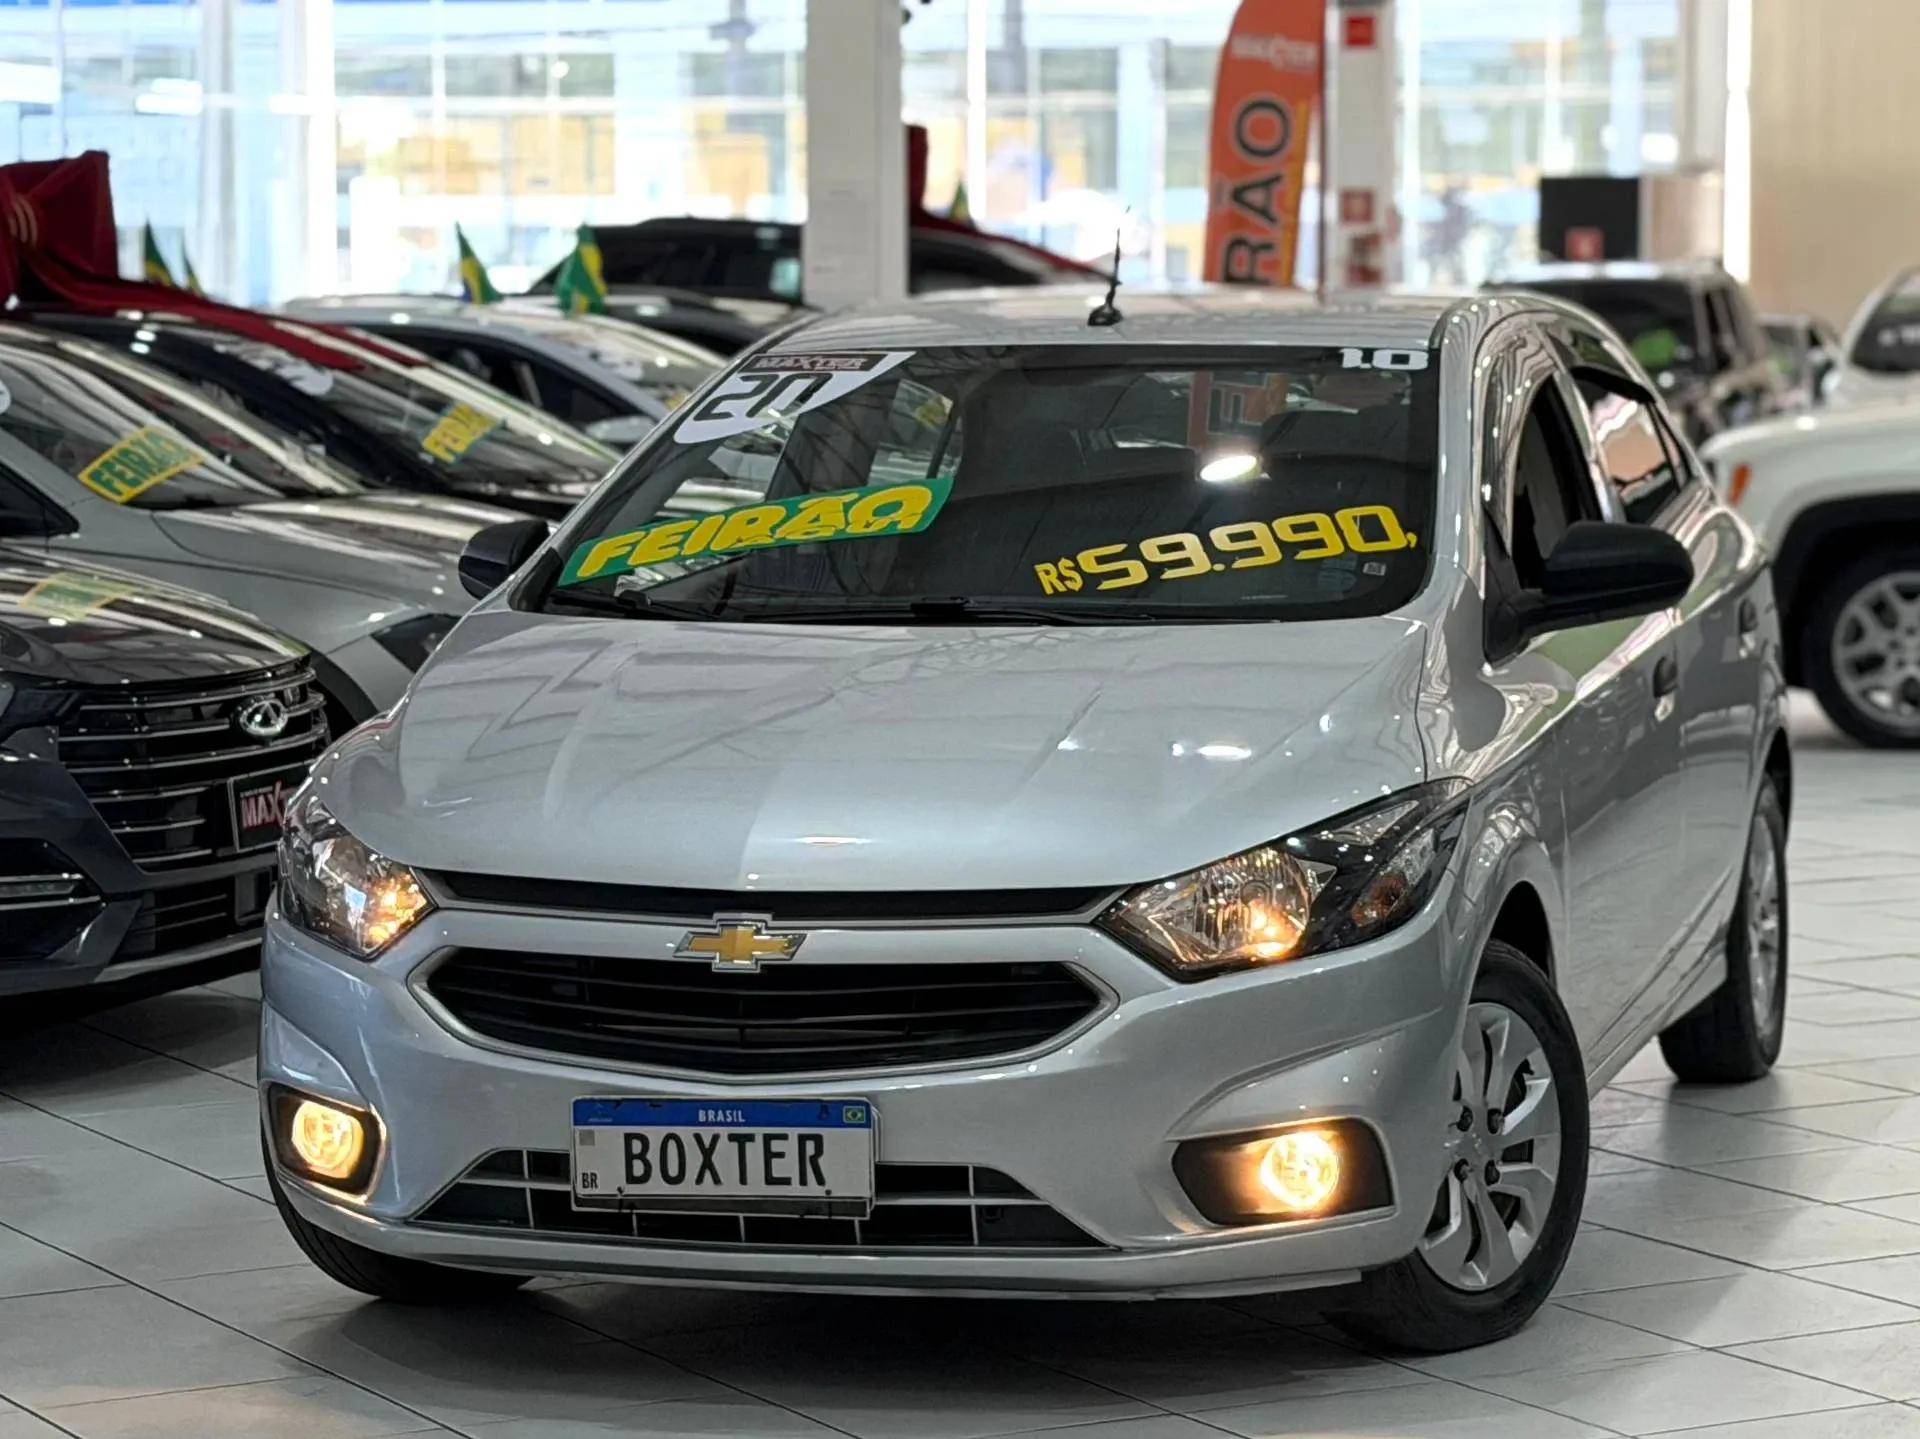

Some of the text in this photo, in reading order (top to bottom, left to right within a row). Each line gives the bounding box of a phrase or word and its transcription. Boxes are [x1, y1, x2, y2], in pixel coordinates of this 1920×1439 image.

[1340, 347, 1429, 371] 1.0
[575, 485, 933, 578] FEIRÃO
[241, 780, 297, 828] MAX
[698, 1108, 746, 1123] BRASIL
[623, 1132, 826, 1187] BOXTER
[582, 1172, 599, 1189] BR
